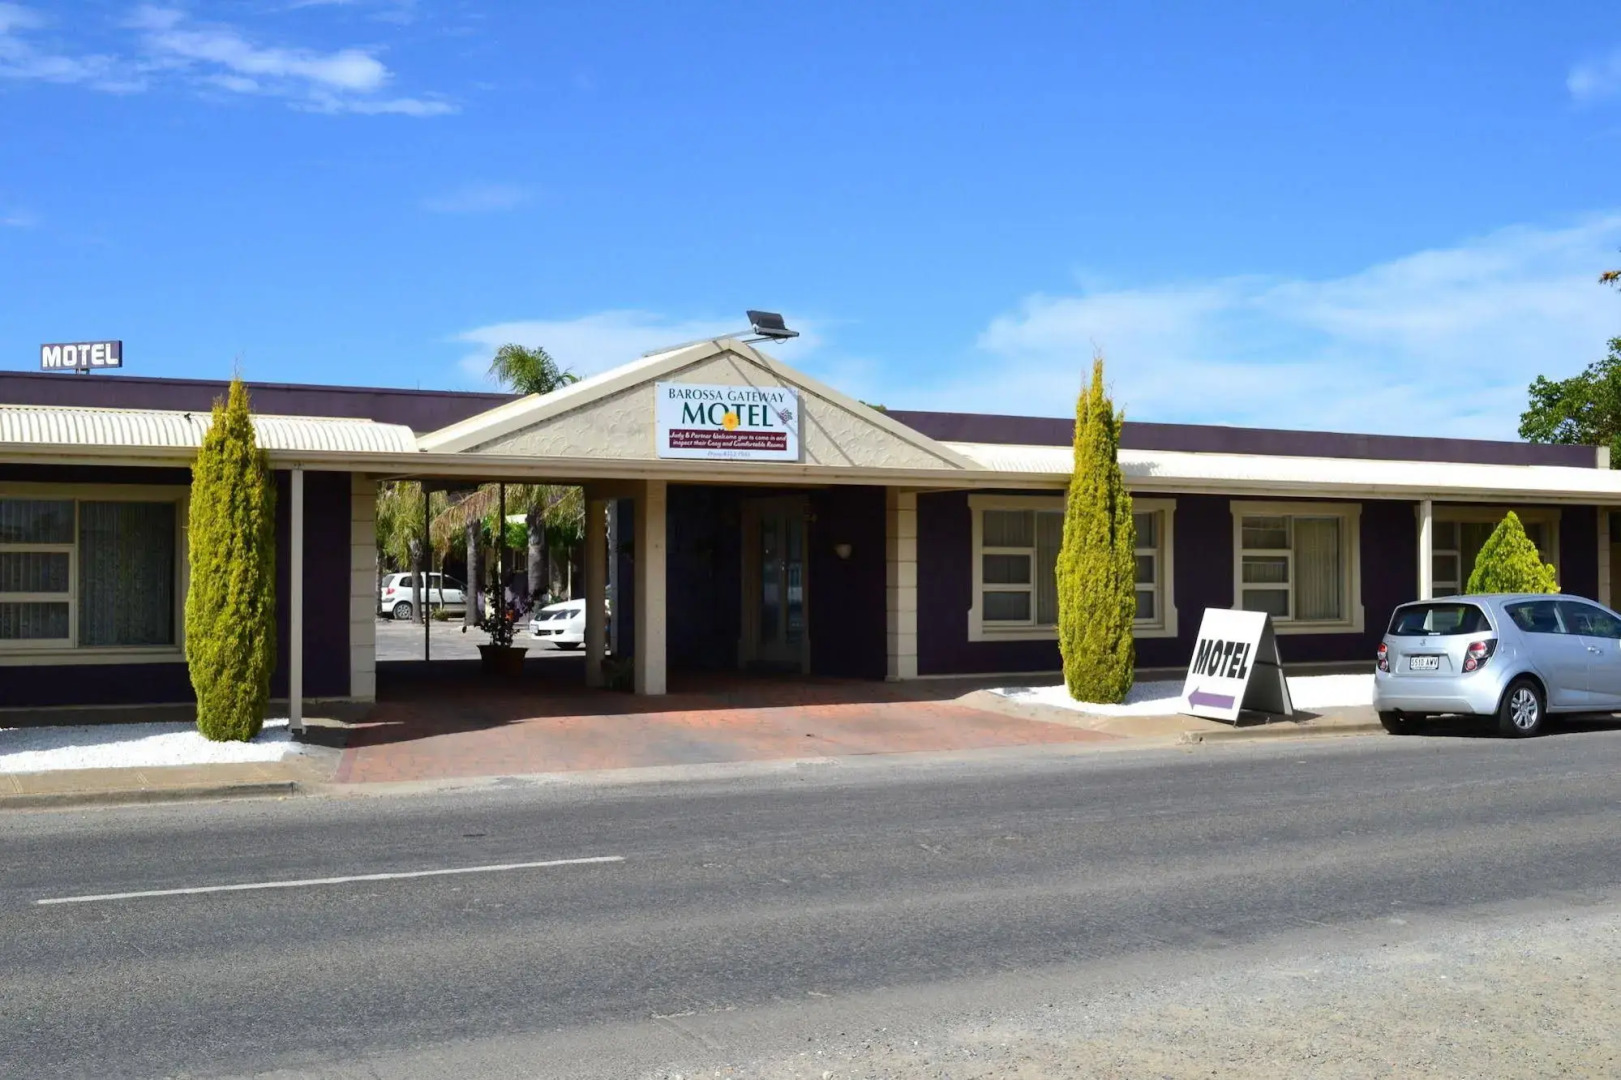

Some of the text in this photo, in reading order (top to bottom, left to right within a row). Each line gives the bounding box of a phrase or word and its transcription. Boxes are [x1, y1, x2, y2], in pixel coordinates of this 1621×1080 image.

[42, 343, 118, 367] MOTEL
[669, 388, 785, 403] BAROSSA GATEWAY
[681, 401, 773, 426] MOTEL
[1192, 638, 1251, 680] MOTEL
